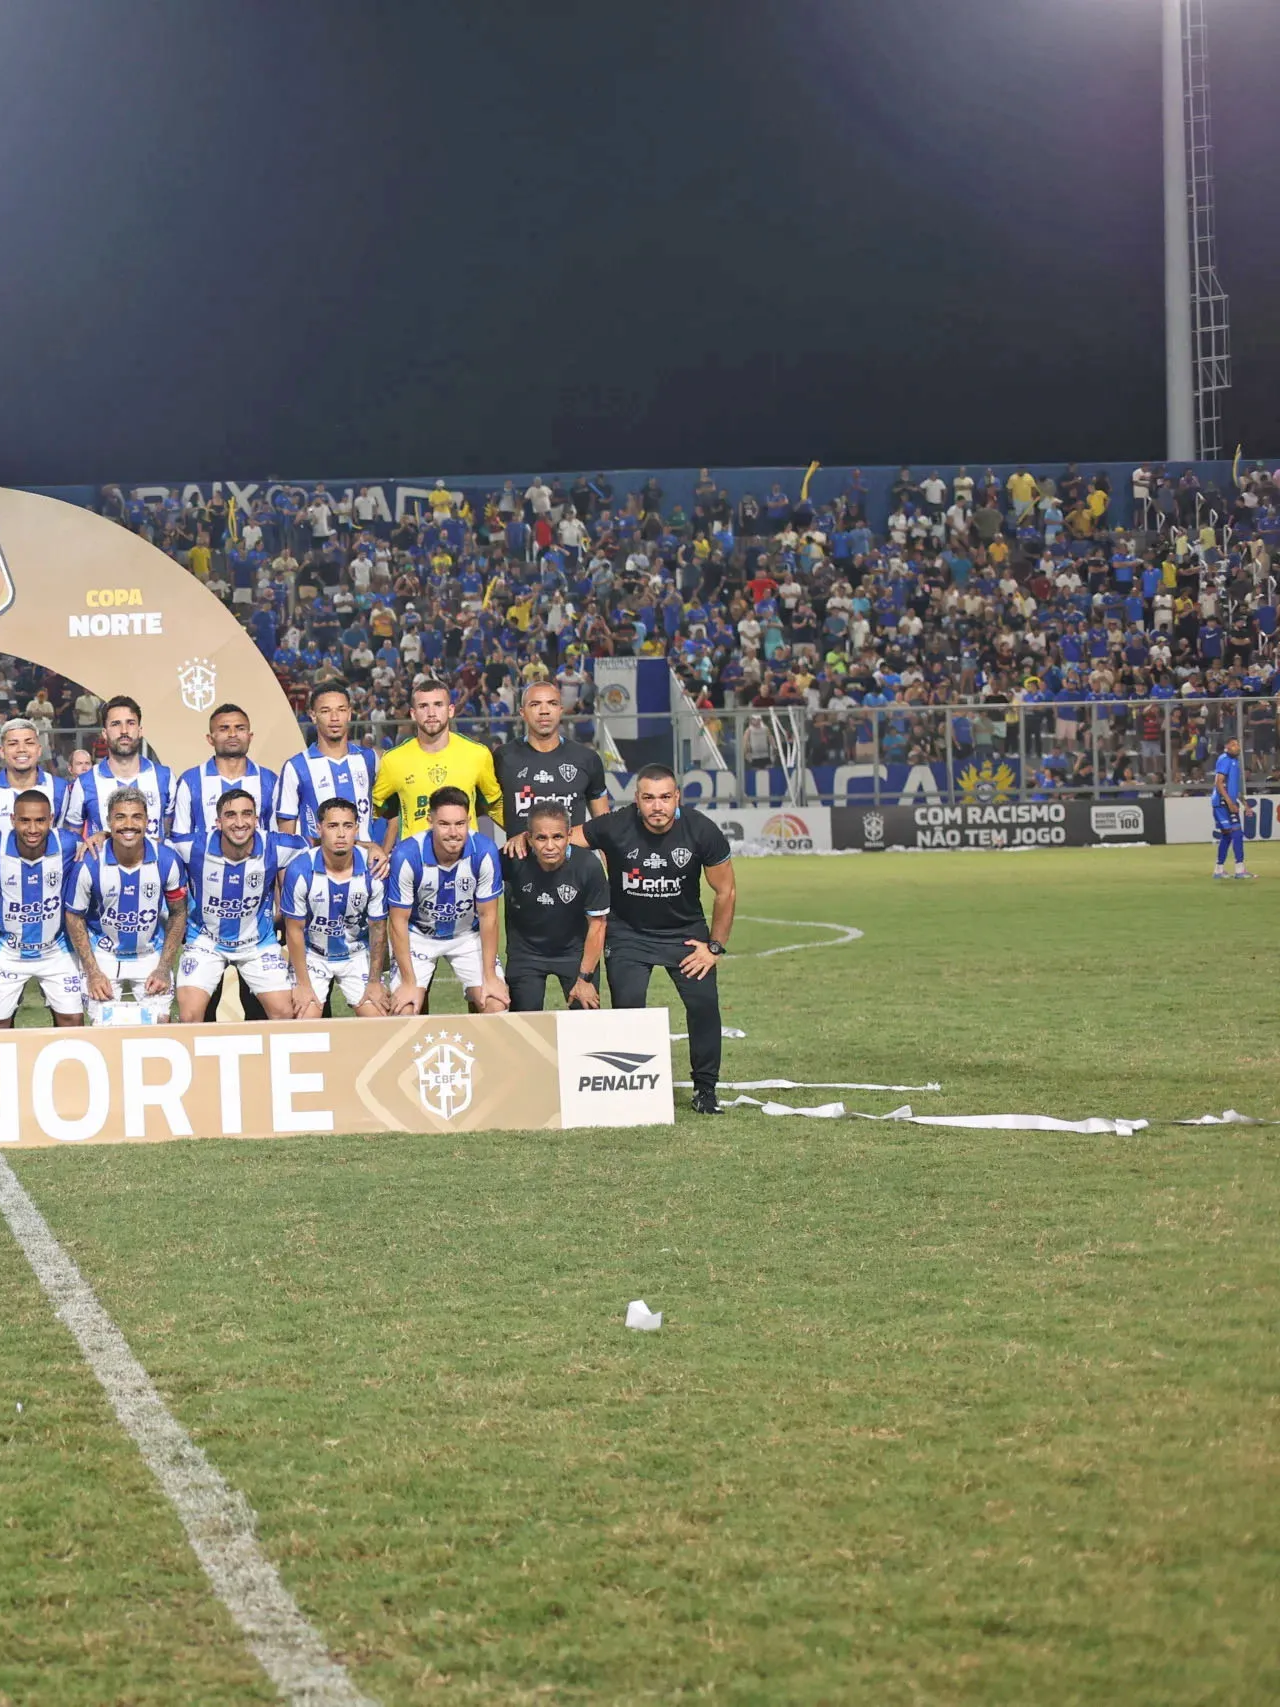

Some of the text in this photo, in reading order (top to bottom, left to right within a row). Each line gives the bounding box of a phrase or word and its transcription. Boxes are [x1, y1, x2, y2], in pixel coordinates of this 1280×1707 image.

[86, 588, 143, 607] COPA
[69, 612, 163, 637] NORTE
[915, 804, 1066, 826] COM RACISMO
[1120, 818, 1139, 829] 100
[917, 826, 1066, 847] NÃO TEM JOGO
[9, 901, 41, 913] Bet
[209, 896, 241, 910] Bet
[423, 900, 455, 915] Bet
[18, 912, 55, 923] Sorte
[107, 908, 137, 922] Bet
[216, 909, 253, 919] Sorte
[430, 912, 467, 922] Sorte
[114, 922, 150, 932] Sorte
[434, 1074, 456, 1085] CBF
[578, 1074, 660, 1092] PENALTY
